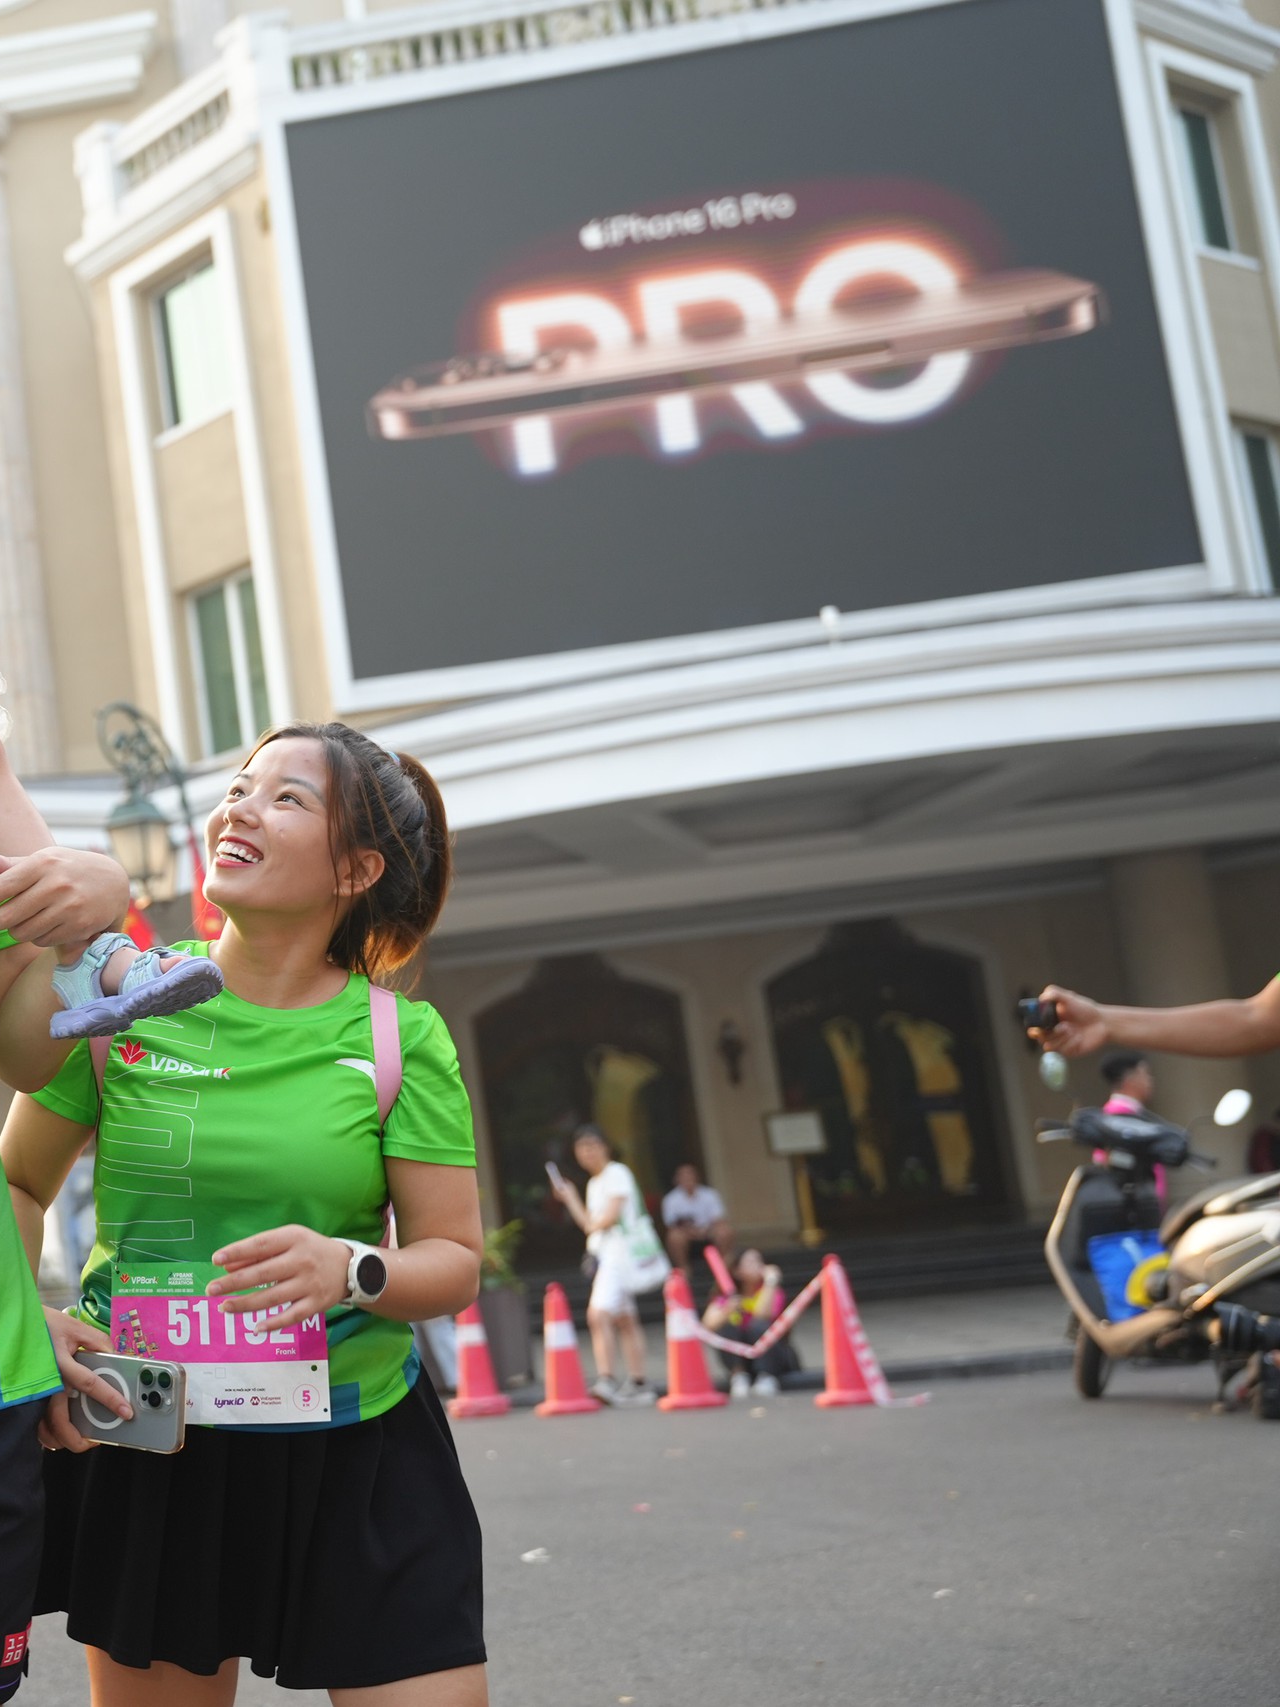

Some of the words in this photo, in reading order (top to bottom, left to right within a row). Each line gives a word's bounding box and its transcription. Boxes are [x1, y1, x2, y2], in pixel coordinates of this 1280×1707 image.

[604, 207, 707, 248] iPhone
[703, 196, 742, 231] 16
[741, 192, 797, 226] Pro
[496, 239, 973, 475] PRO
[131, 1276, 159, 1284] VPBank
[167, 1299, 295, 1346] 51192
[301, 1311, 320, 1332] M
[302, 1390, 311, 1403] 5
